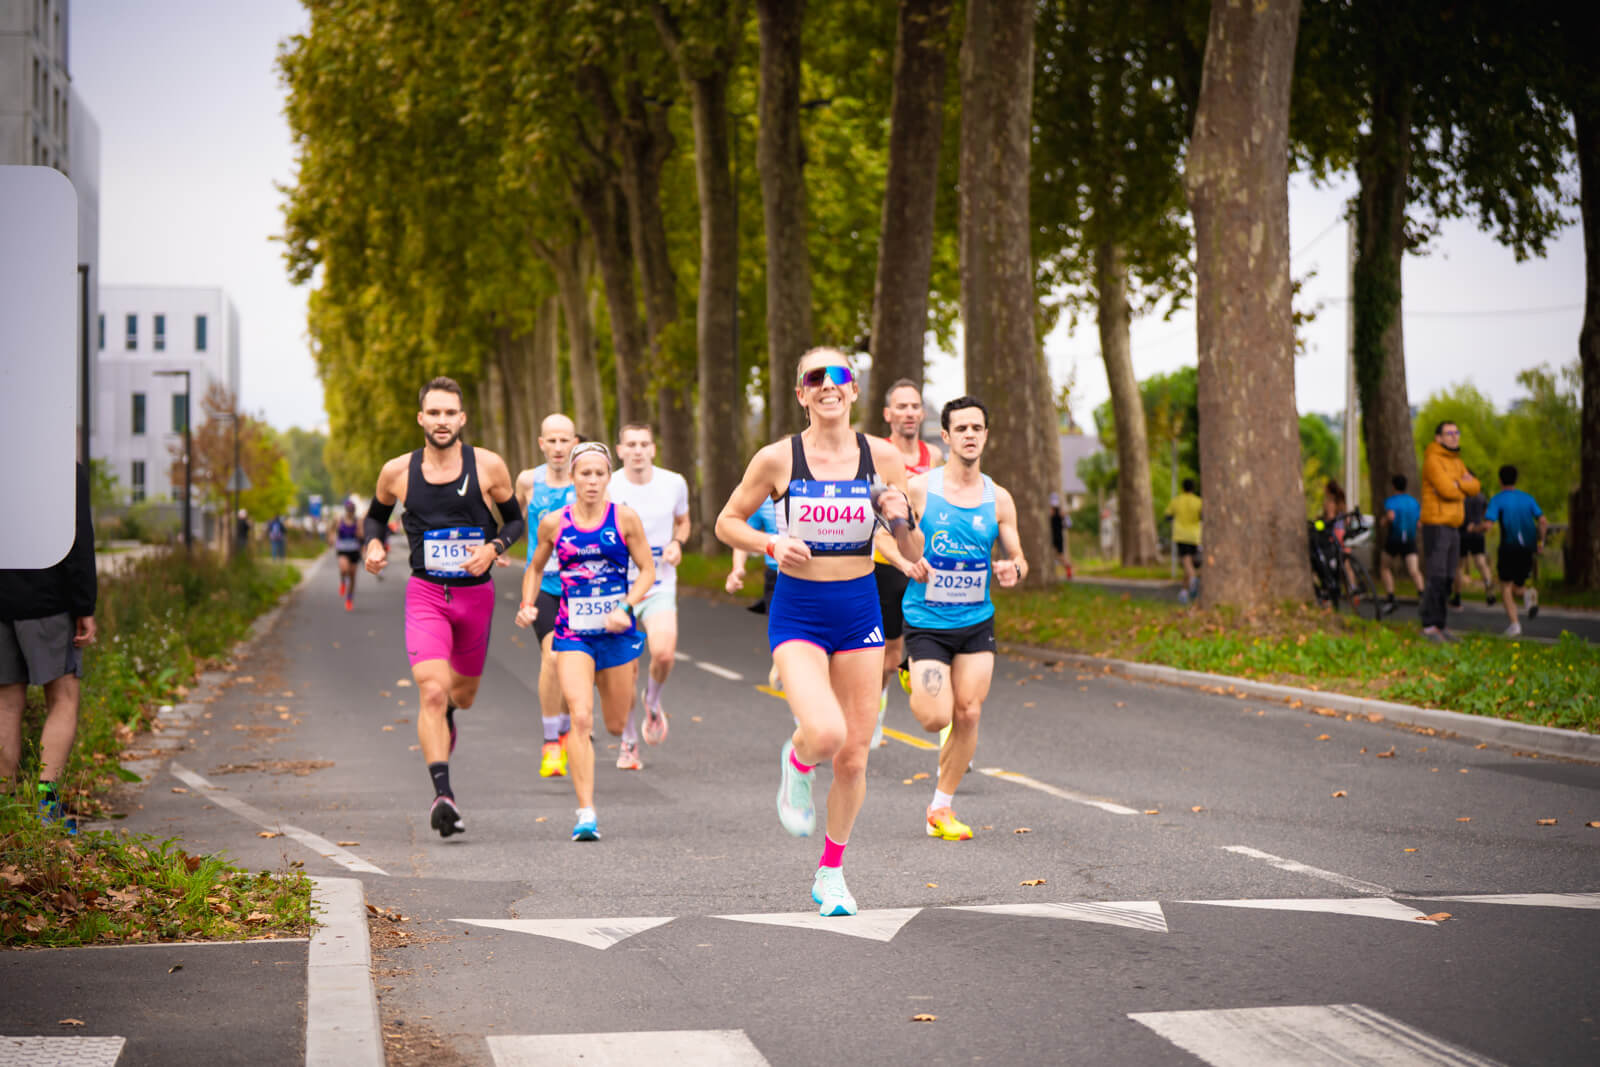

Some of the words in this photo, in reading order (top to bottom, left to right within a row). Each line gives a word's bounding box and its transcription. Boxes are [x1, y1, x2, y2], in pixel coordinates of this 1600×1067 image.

[798, 504, 866, 524] 20044
[817, 527, 845, 536] SOPHIE
[431, 544, 478, 558] 2161
[576, 546, 602, 556] TOURS
[933, 574, 982, 589] 20294
